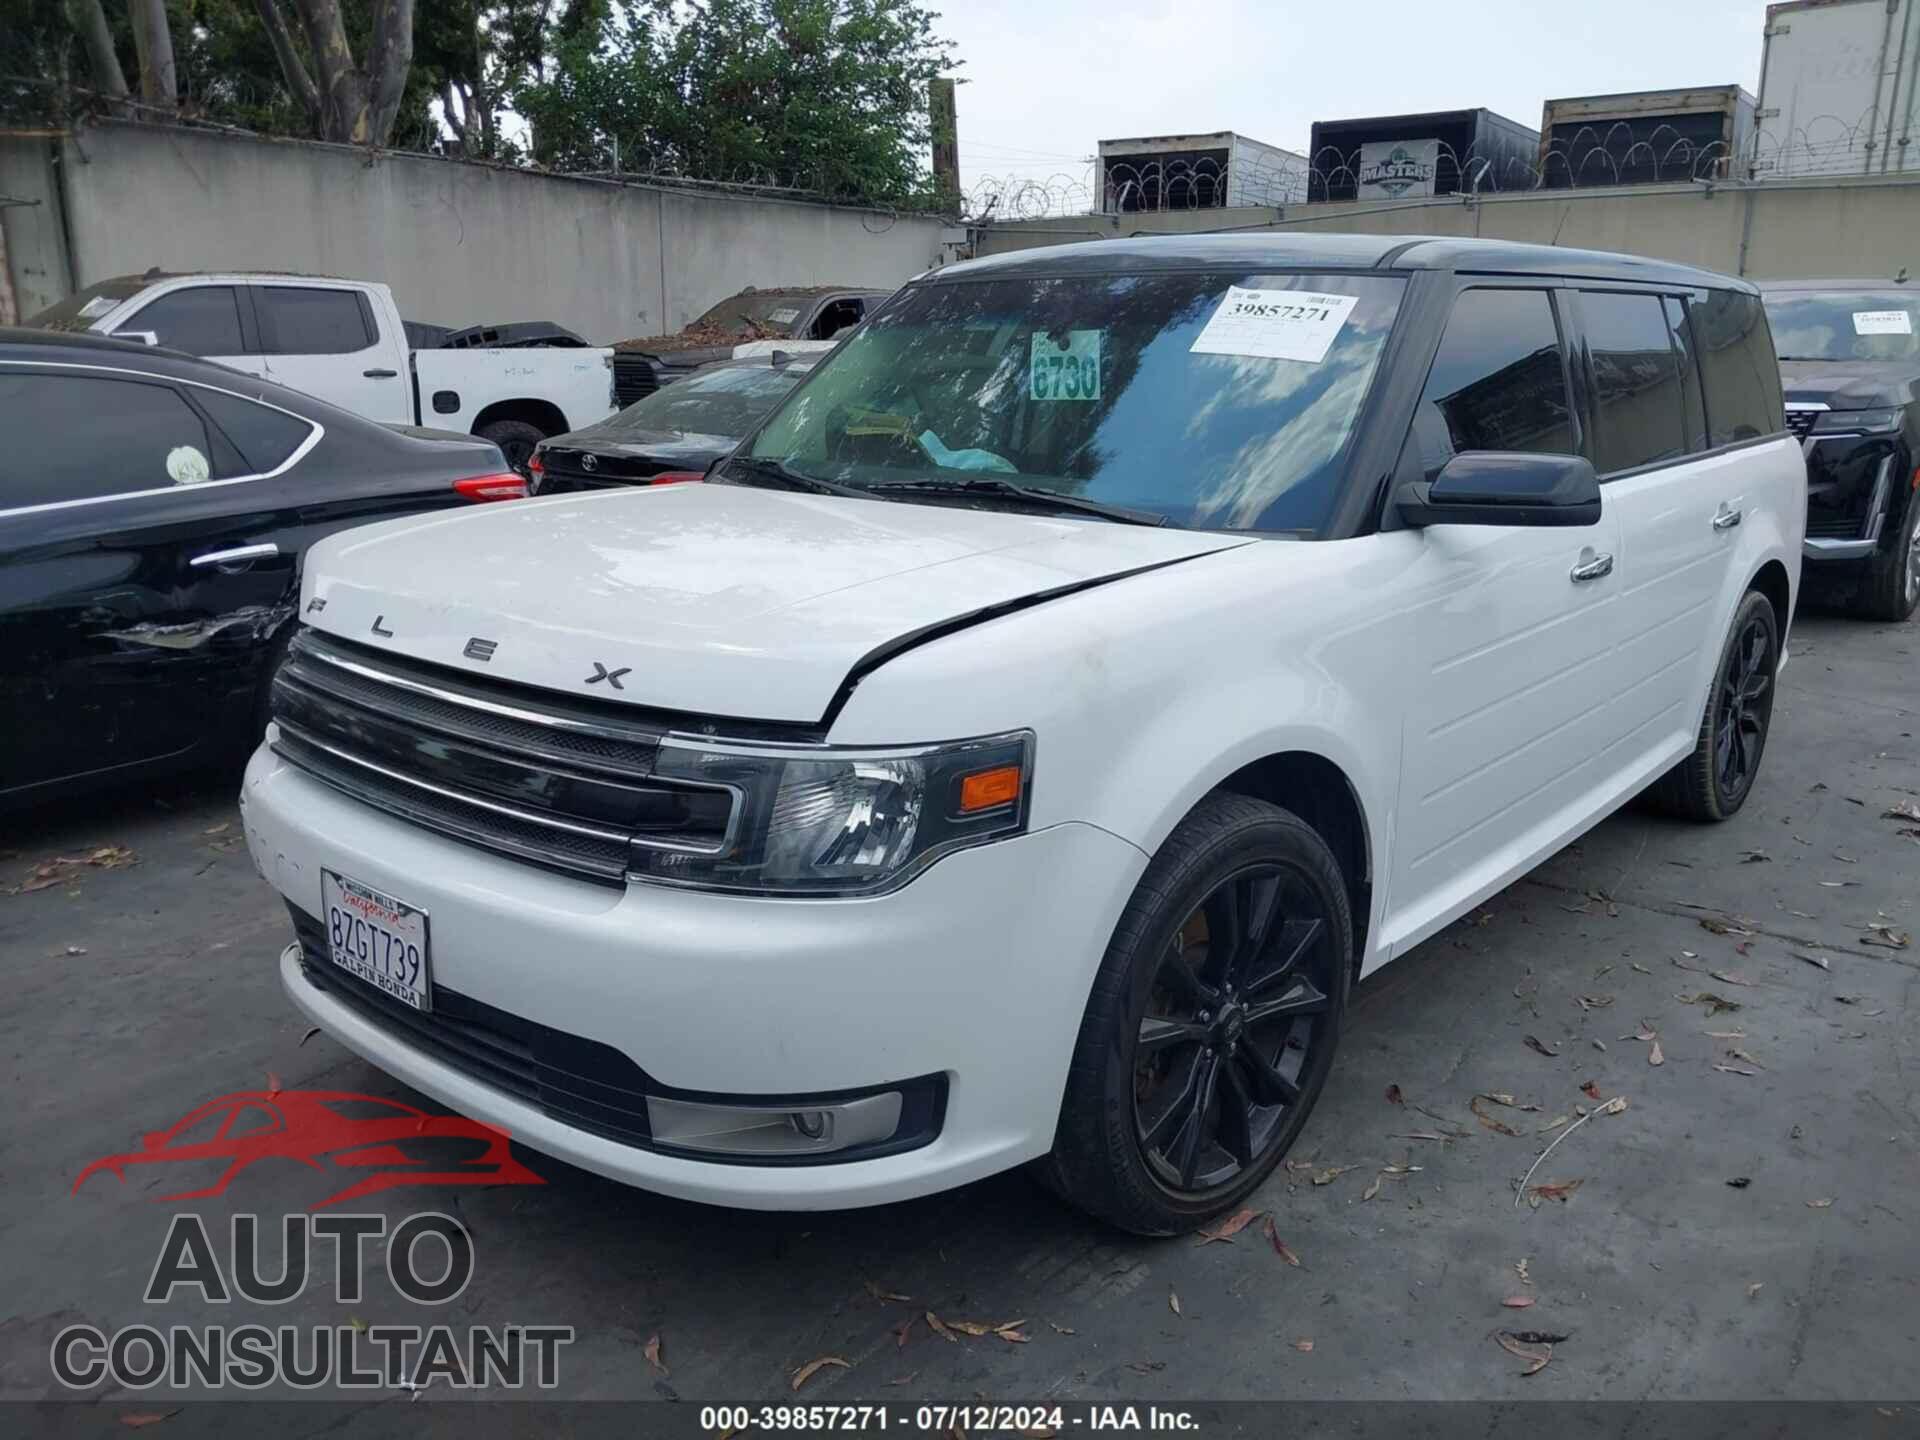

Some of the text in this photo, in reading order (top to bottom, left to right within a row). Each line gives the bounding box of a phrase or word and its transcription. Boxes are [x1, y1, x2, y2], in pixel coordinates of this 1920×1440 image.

[1361, 163, 1434, 184] MASTERS
[1228, 303, 1330, 322] 39857271
[1033, 355, 1097, 398] 6730
[306, 596, 632, 690] FLEX
[331, 906, 420, 987] 8ZGT739
[378, 974, 418, 1006] HONDA
